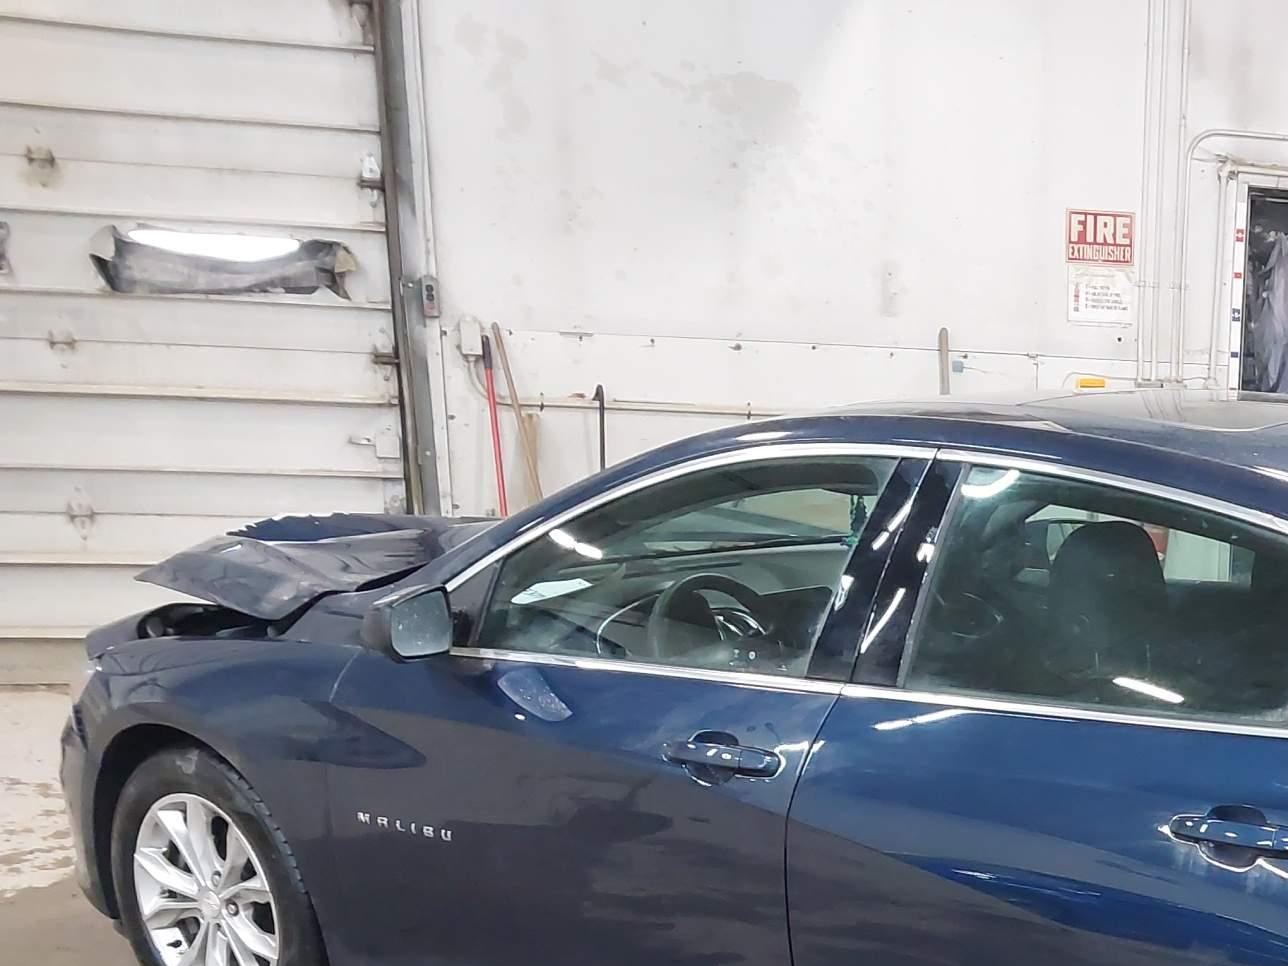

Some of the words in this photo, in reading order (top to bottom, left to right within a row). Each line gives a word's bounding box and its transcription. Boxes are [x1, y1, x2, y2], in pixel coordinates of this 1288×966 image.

[1070, 213, 1131, 245] FIRE
[1068, 243, 1131, 262] EXTINGUISHER
[357, 811, 452, 841] MALIBU
